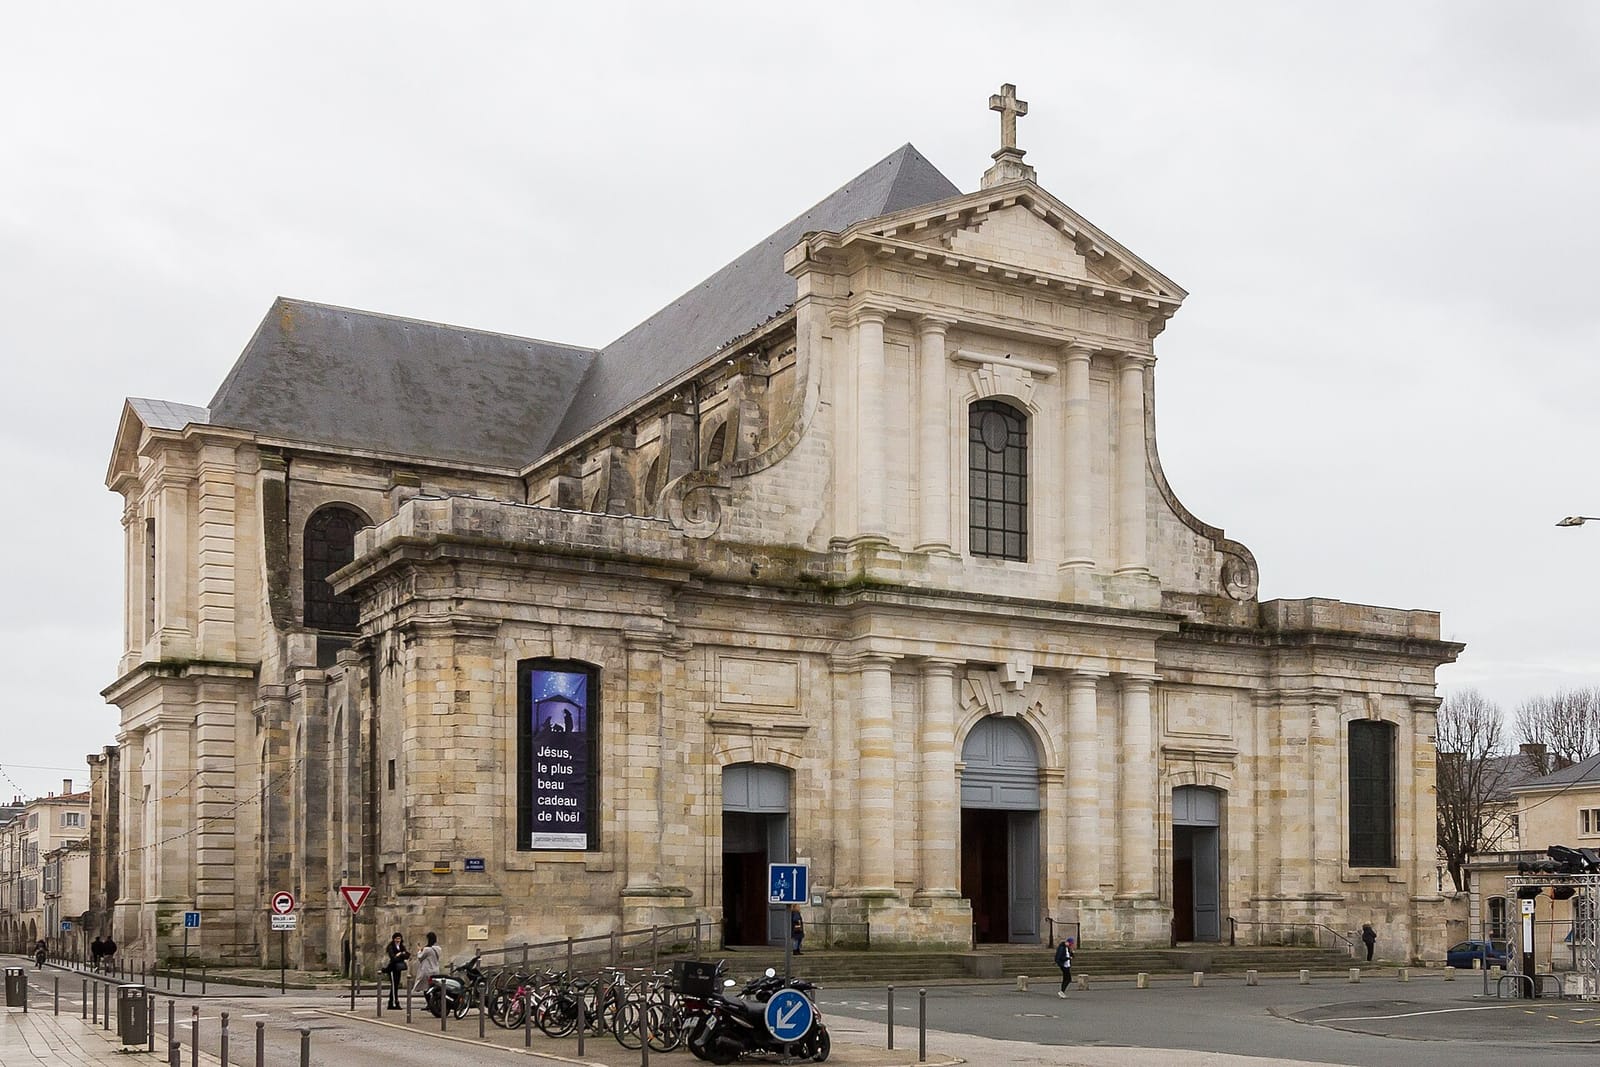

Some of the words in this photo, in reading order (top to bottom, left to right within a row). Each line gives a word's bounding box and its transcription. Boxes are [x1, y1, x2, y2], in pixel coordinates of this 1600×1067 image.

[537, 746, 572, 760] Jésus,
[537, 762, 547, 773] le
[551, 763, 573, 775] plus
[537, 778, 564, 790] beau
[537, 795, 577, 806] cadeau
[537, 811, 552, 821] de
[555, 811, 580, 822] Noël
